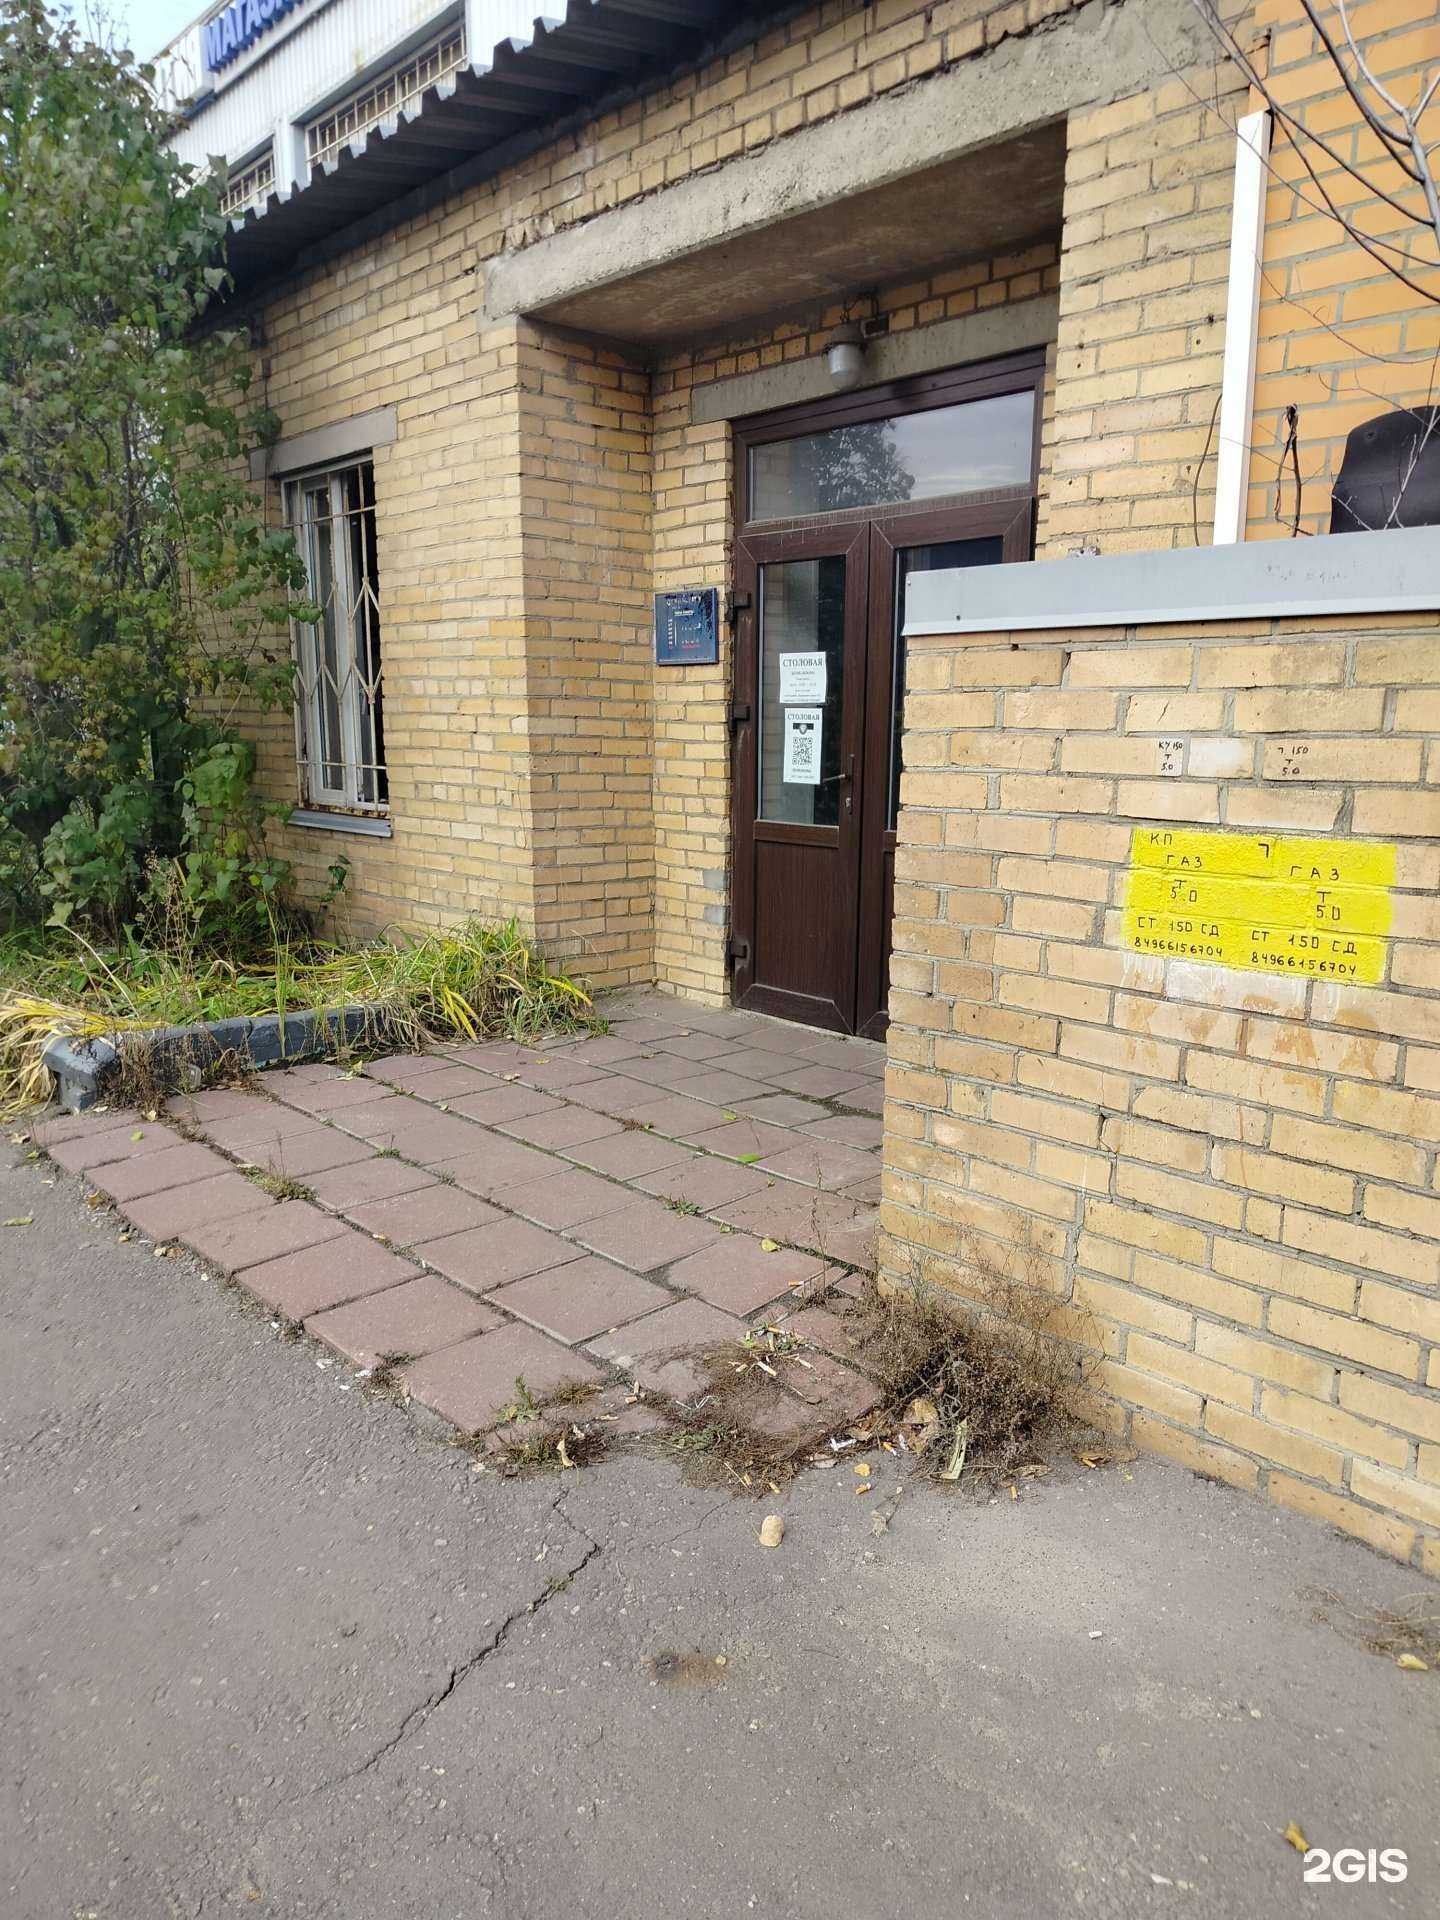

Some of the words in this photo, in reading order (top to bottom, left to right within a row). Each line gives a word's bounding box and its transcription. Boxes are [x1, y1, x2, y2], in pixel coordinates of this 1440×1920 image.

[783, 657, 823, 667] СТОЛОВАЯ
[1291, 746, 1309, 755] 150
[1150, 833, 1173, 846] КП
[1166, 854, 1203, 868] ГАЗ
[1290, 865, 1340, 881] ГАЗ
[1316, 891, 1332, 903] Т
[1137, 916, 1157, 929] СТ
[1168, 919, 1193, 932] 150
[1200, 922, 1220, 937] СД
[1134, 936, 1223, 958] 84966156704
[1251, 929, 1270, 942] СТ
[1287, 933, 1319, 949] 150
[1331, 940, 1358, 956] СД
[1251, 951, 1357, 975] 84966156704
